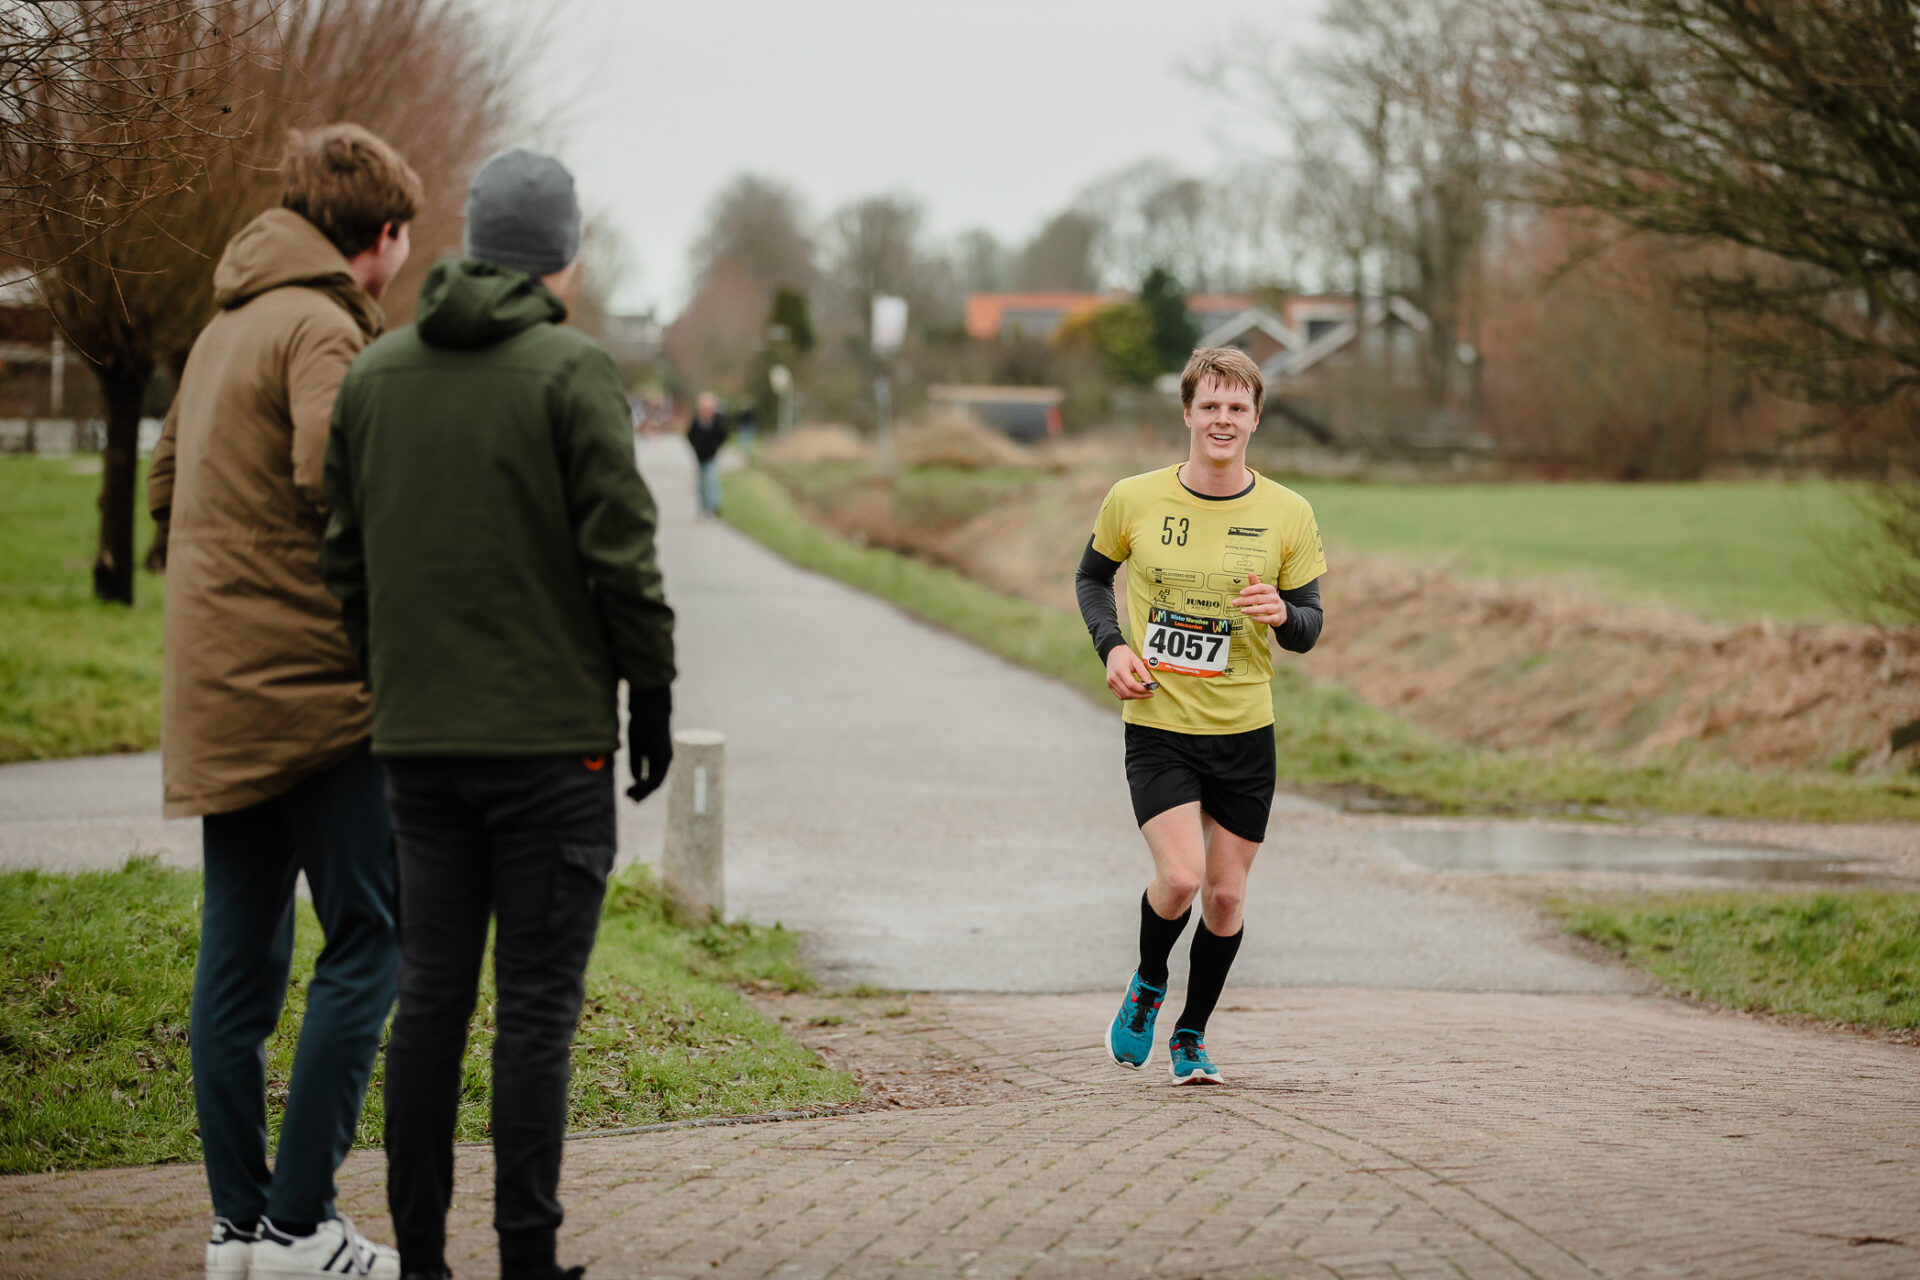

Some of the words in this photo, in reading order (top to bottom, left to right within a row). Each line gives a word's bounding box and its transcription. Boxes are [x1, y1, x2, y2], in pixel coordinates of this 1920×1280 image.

[1161, 516, 1190, 547] 53
[1186, 598, 1220, 608] JUMBO
[1170, 613, 1186, 622] Winter
[1186, 617, 1209, 626] Marathon
[1149, 627, 1224, 663] 4057
